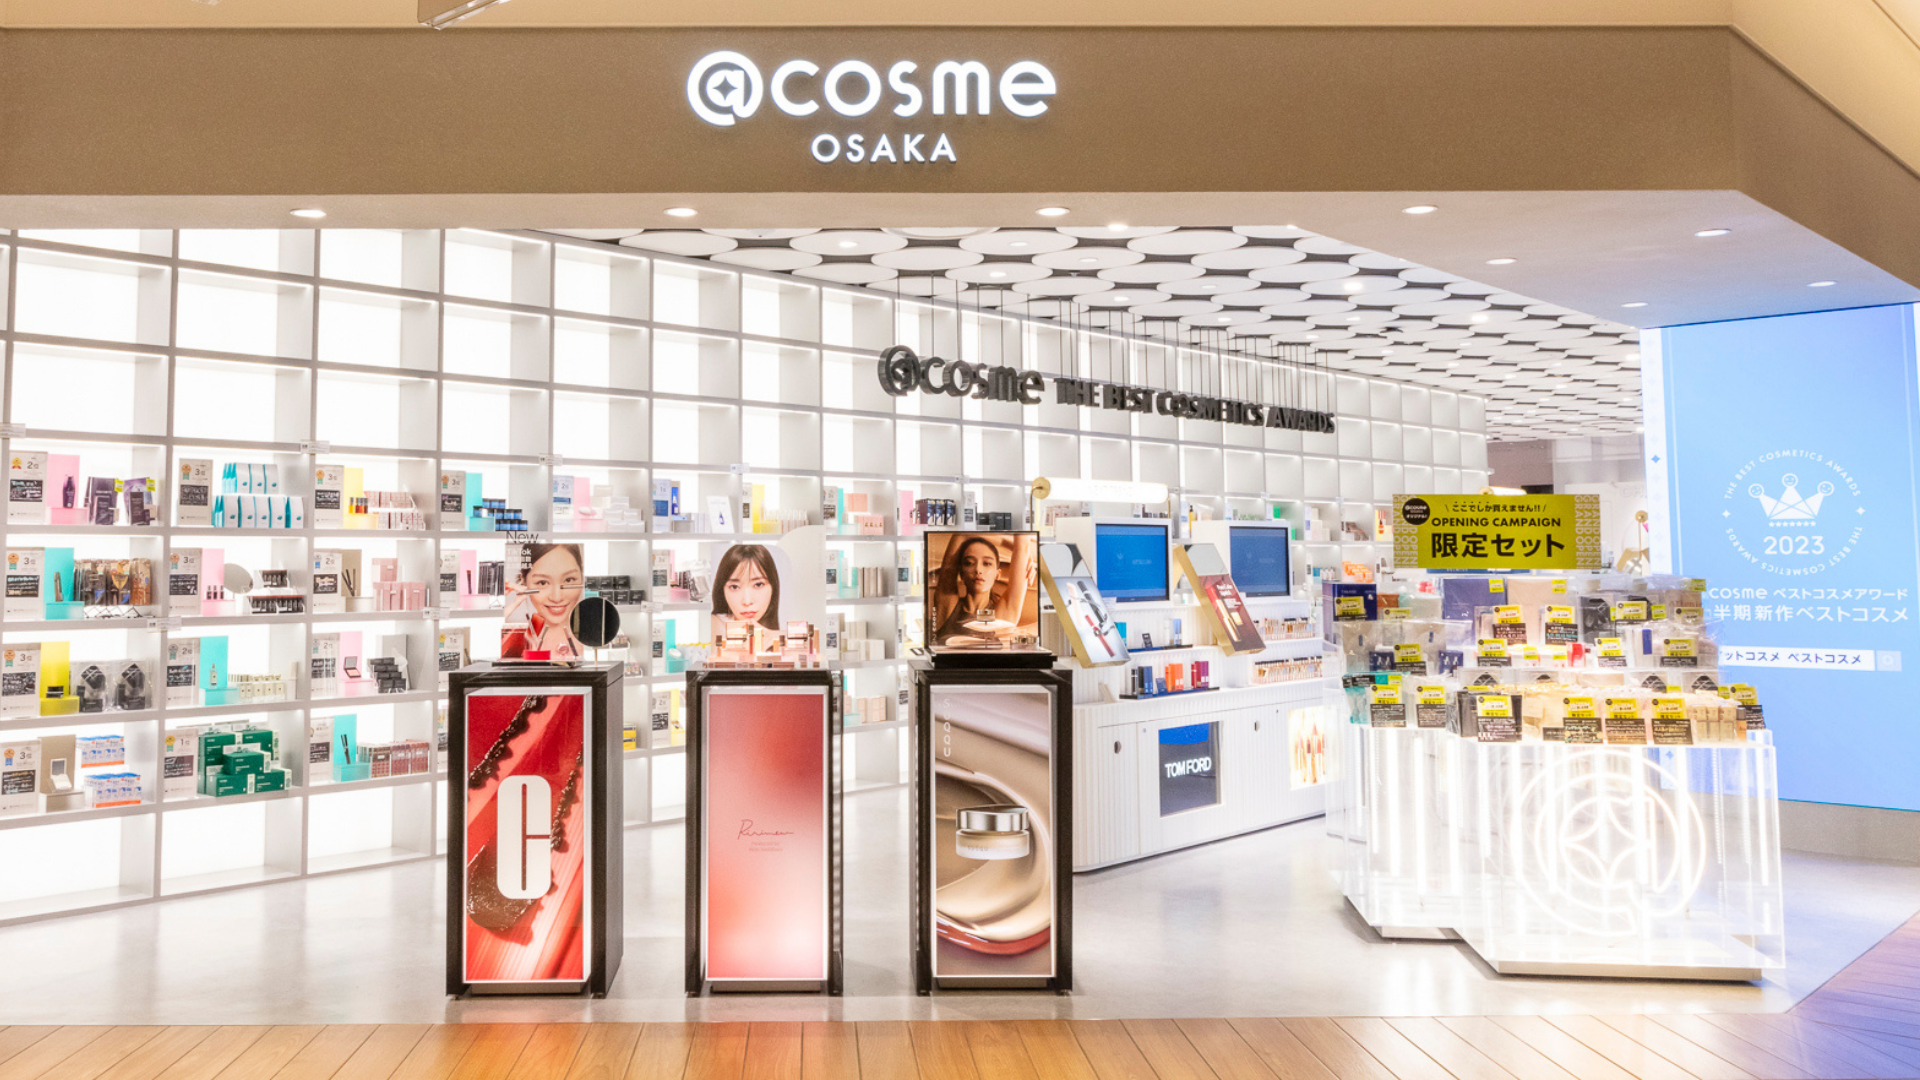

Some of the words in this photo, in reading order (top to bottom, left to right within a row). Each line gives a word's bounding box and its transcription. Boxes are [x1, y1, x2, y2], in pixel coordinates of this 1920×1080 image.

[687, 50, 1056, 127] @cosme
[811, 132, 957, 163] OSAKA
[878, 345, 1044, 404] @cosme
[1054, 378, 1100, 407] THE
[1103, 384, 1155, 413] BEST
[1157, 391, 1264, 426] COSMETICS
[1266, 406, 1335, 433] AWARDS
[1724, 481, 1737, 499] THE
[1735, 460, 1756, 480] BEST
[1759, 449, 1823, 462] COSMETICS
[1825, 460, 1861, 497] AWARDS
[1431, 517, 1489, 527] OPENING
[1492, 517, 1561, 527] CAMPAIGN
[506, 530, 539, 544] New
[1431, 533, 1565, 558] 限定セット
[1725, 528, 1758, 564] AWARDS
[1763, 535, 1825, 555] 2023
[1849, 526, 1863, 545] THE
[1829, 546, 1851, 566] BEST
[1761, 562, 1826, 575] COSMETICS
[1703, 588, 1768, 599] cosme
[1773, 587, 1908, 600] ベストコスメアワード
[1719, 651, 1780, 661] ットコスメ
[1788, 653, 1861, 664] ベストコスメ
[1164, 761, 1186, 778] TOM
[1186, 756, 1212, 774] FORD
[497, 775, 551, 899] C
